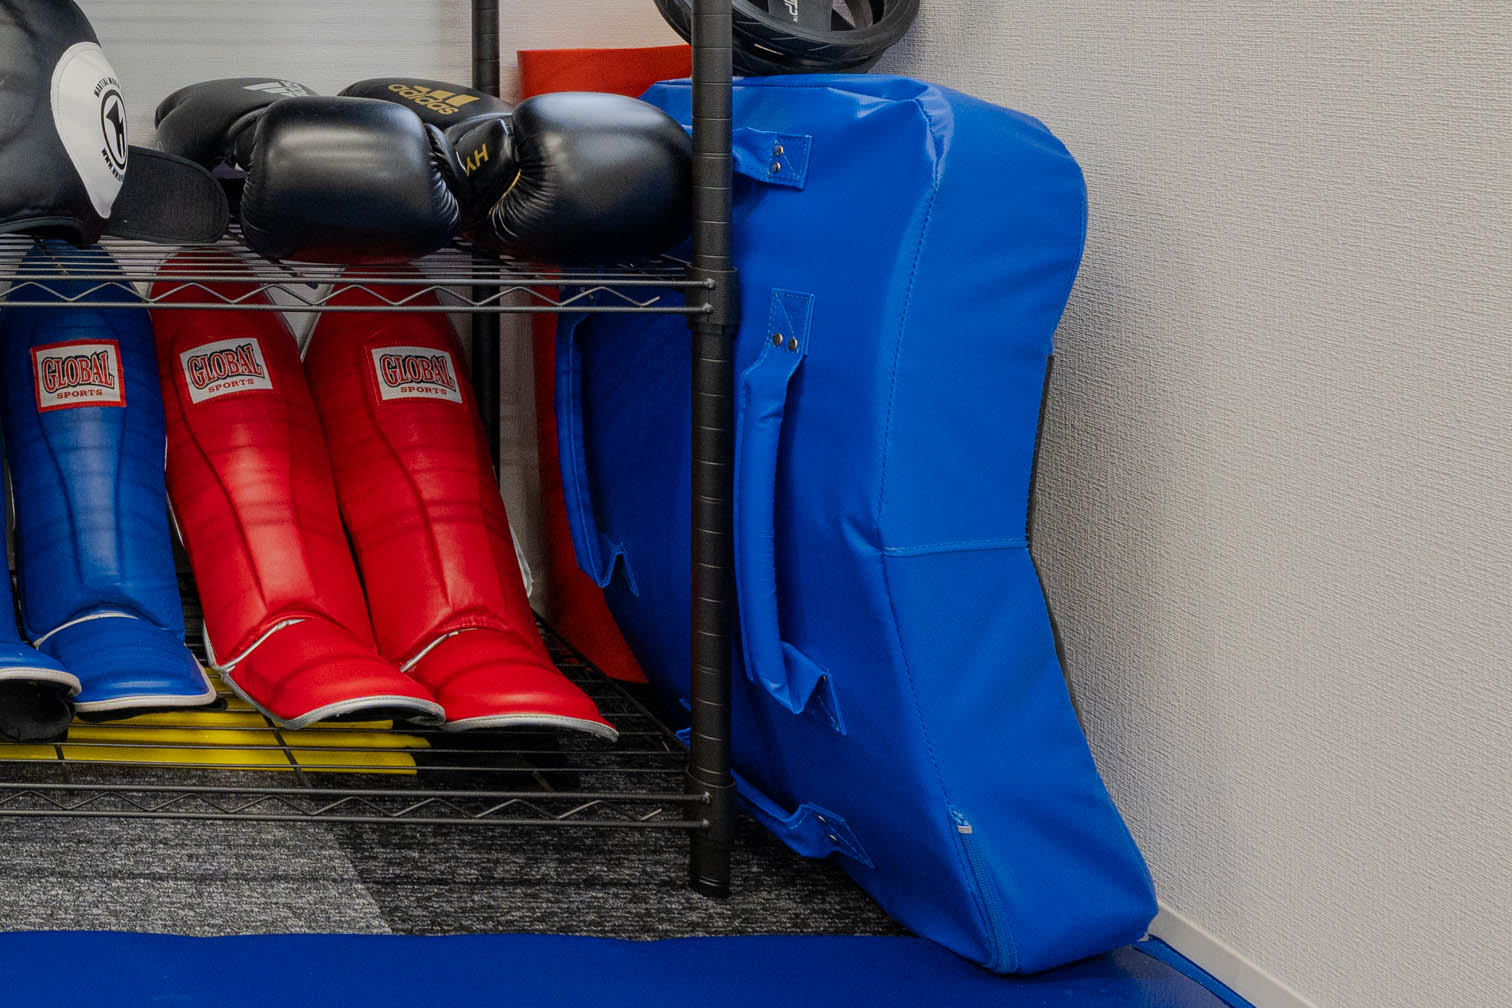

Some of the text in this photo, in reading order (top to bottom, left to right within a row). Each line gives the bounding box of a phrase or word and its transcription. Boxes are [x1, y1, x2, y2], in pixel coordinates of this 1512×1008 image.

[388, 84, 459, 115] adidas
[42, 350, 115, 393] GLOBAL
[188, 343, 265, 390] GLOBAL
[379, 353, 456, 391] GLOBAL
[56, 389, 103, 400] SPORTS
[208, 378, 255, 393] SPORTS
[400, 385, 447, 395] SPORTS
